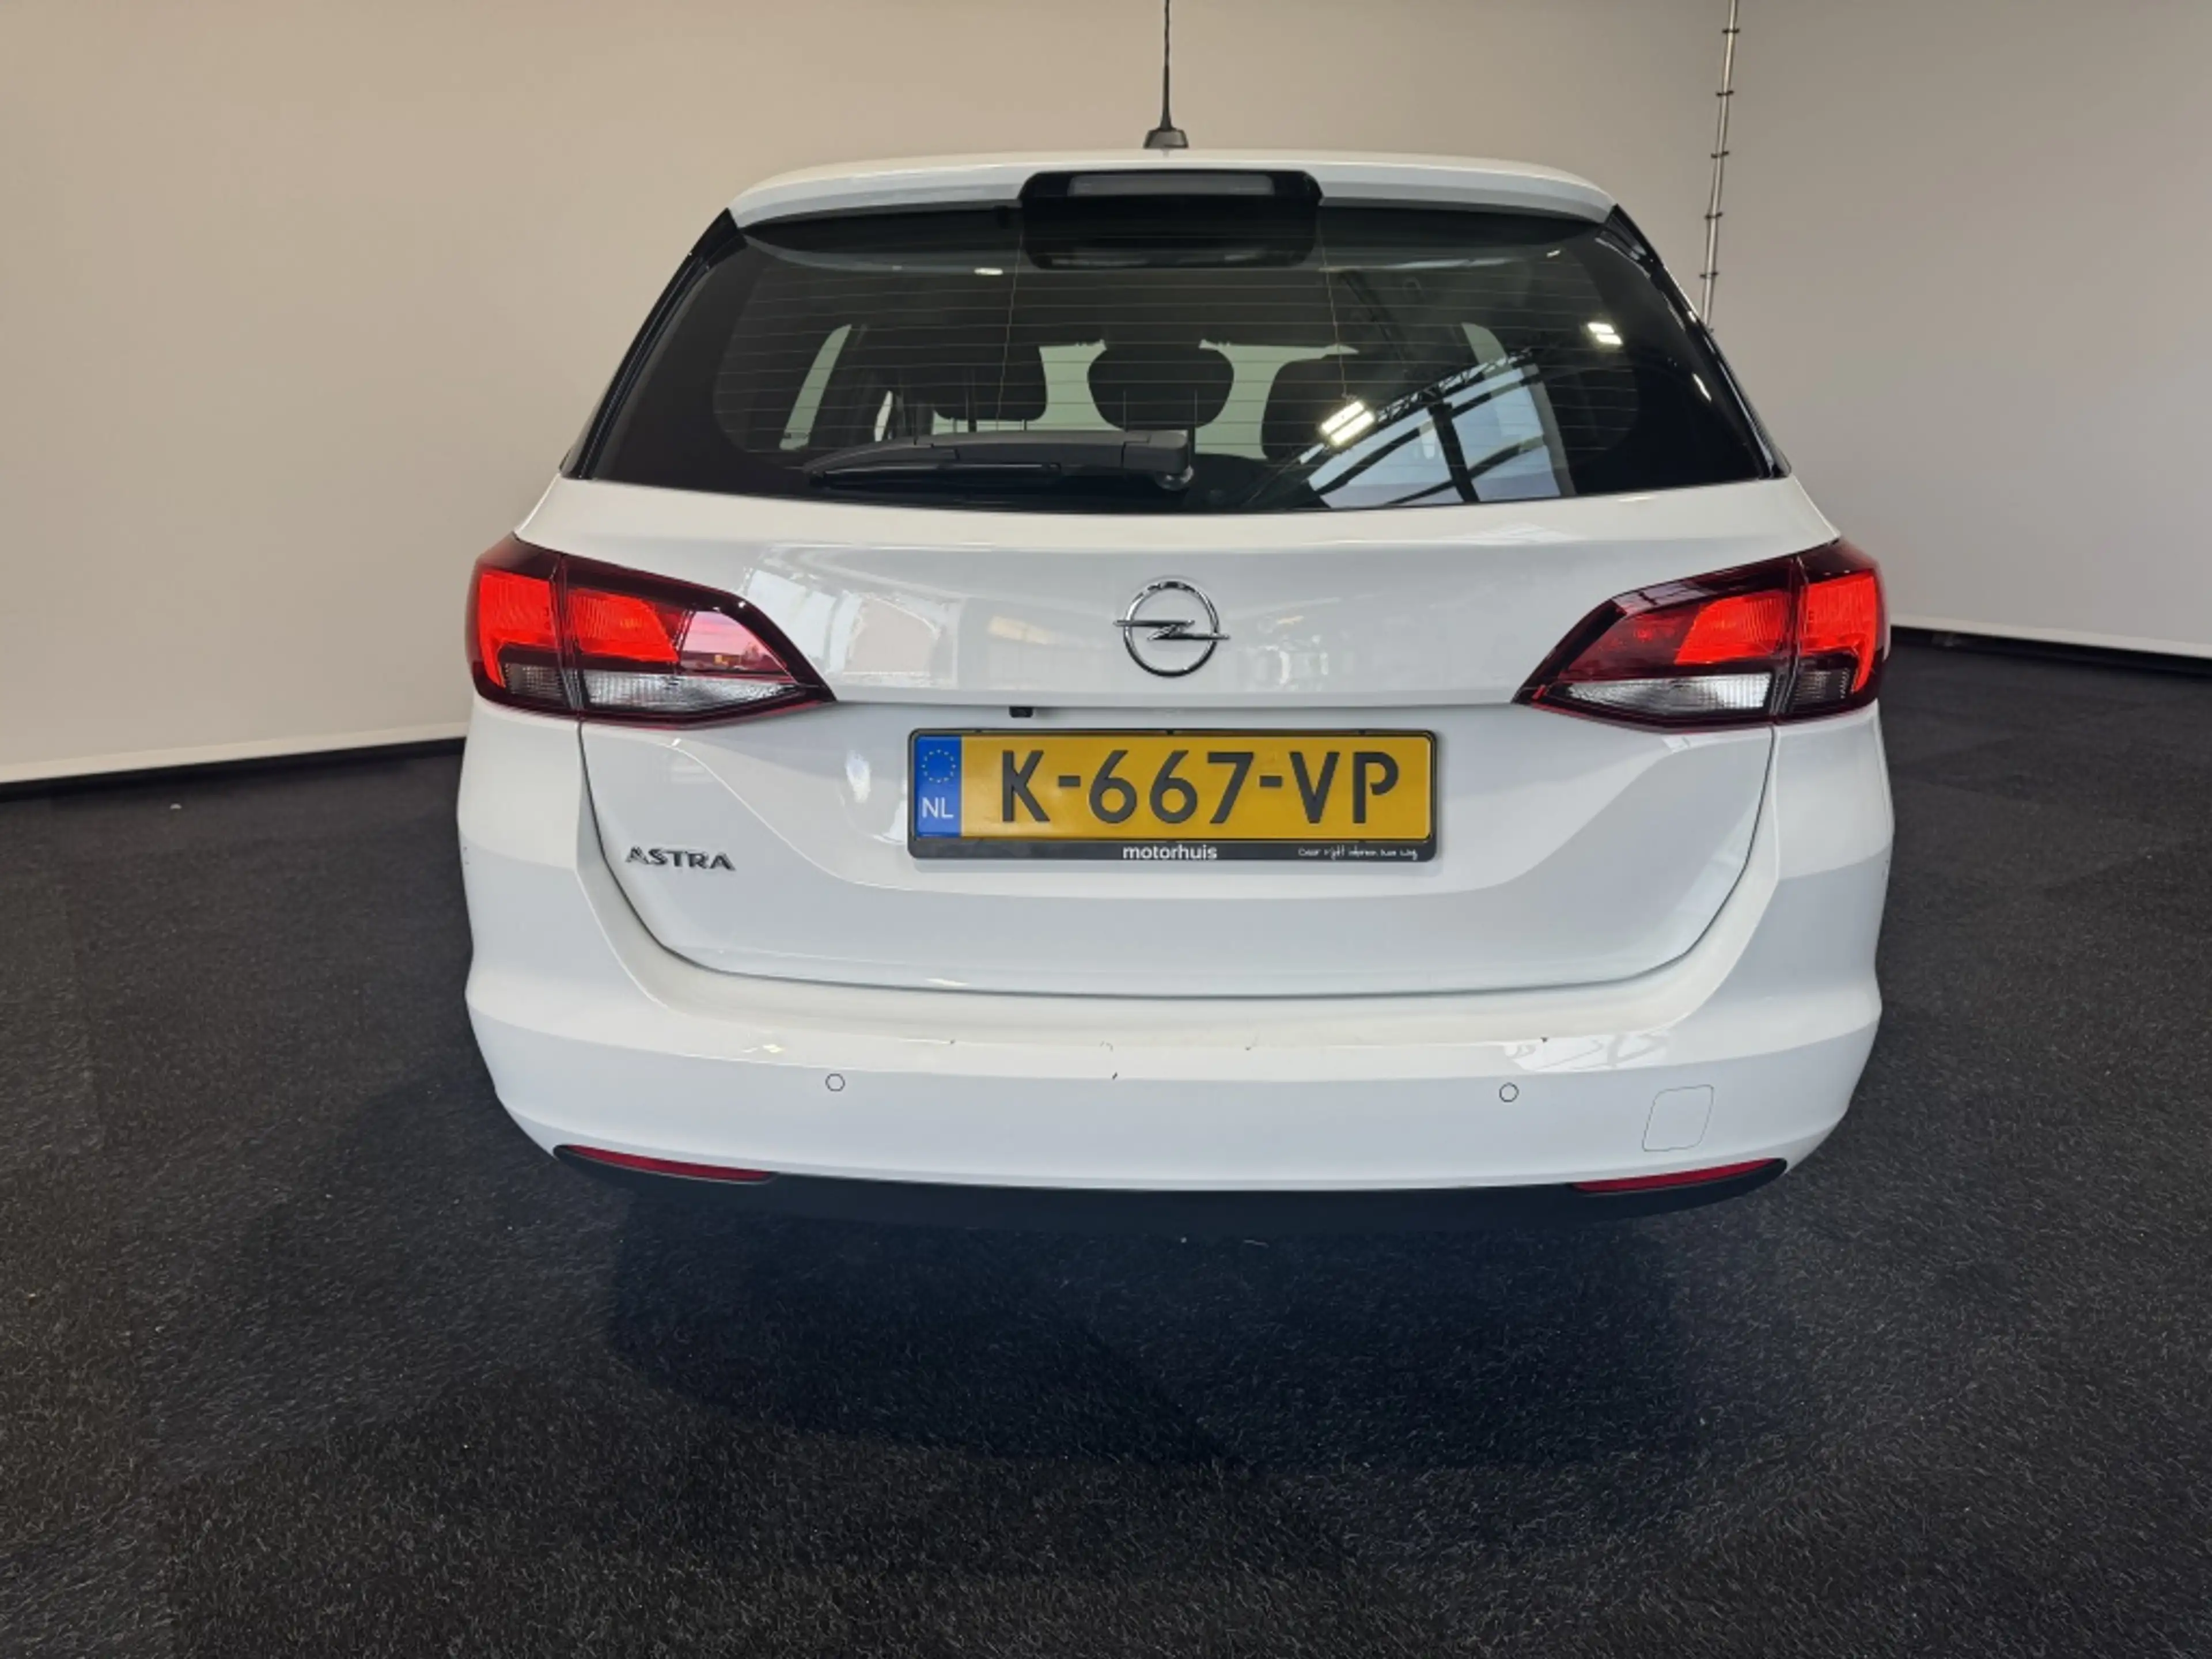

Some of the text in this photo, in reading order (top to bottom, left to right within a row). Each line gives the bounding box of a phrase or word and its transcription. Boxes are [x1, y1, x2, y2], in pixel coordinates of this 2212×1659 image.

[1001, 750, 1399, 824] K-667-VP
[922, 797, 954, 819] NL
[625, 846, 736, 872] ASTRA
[1123, 844, 1217, 859] motorhuis
